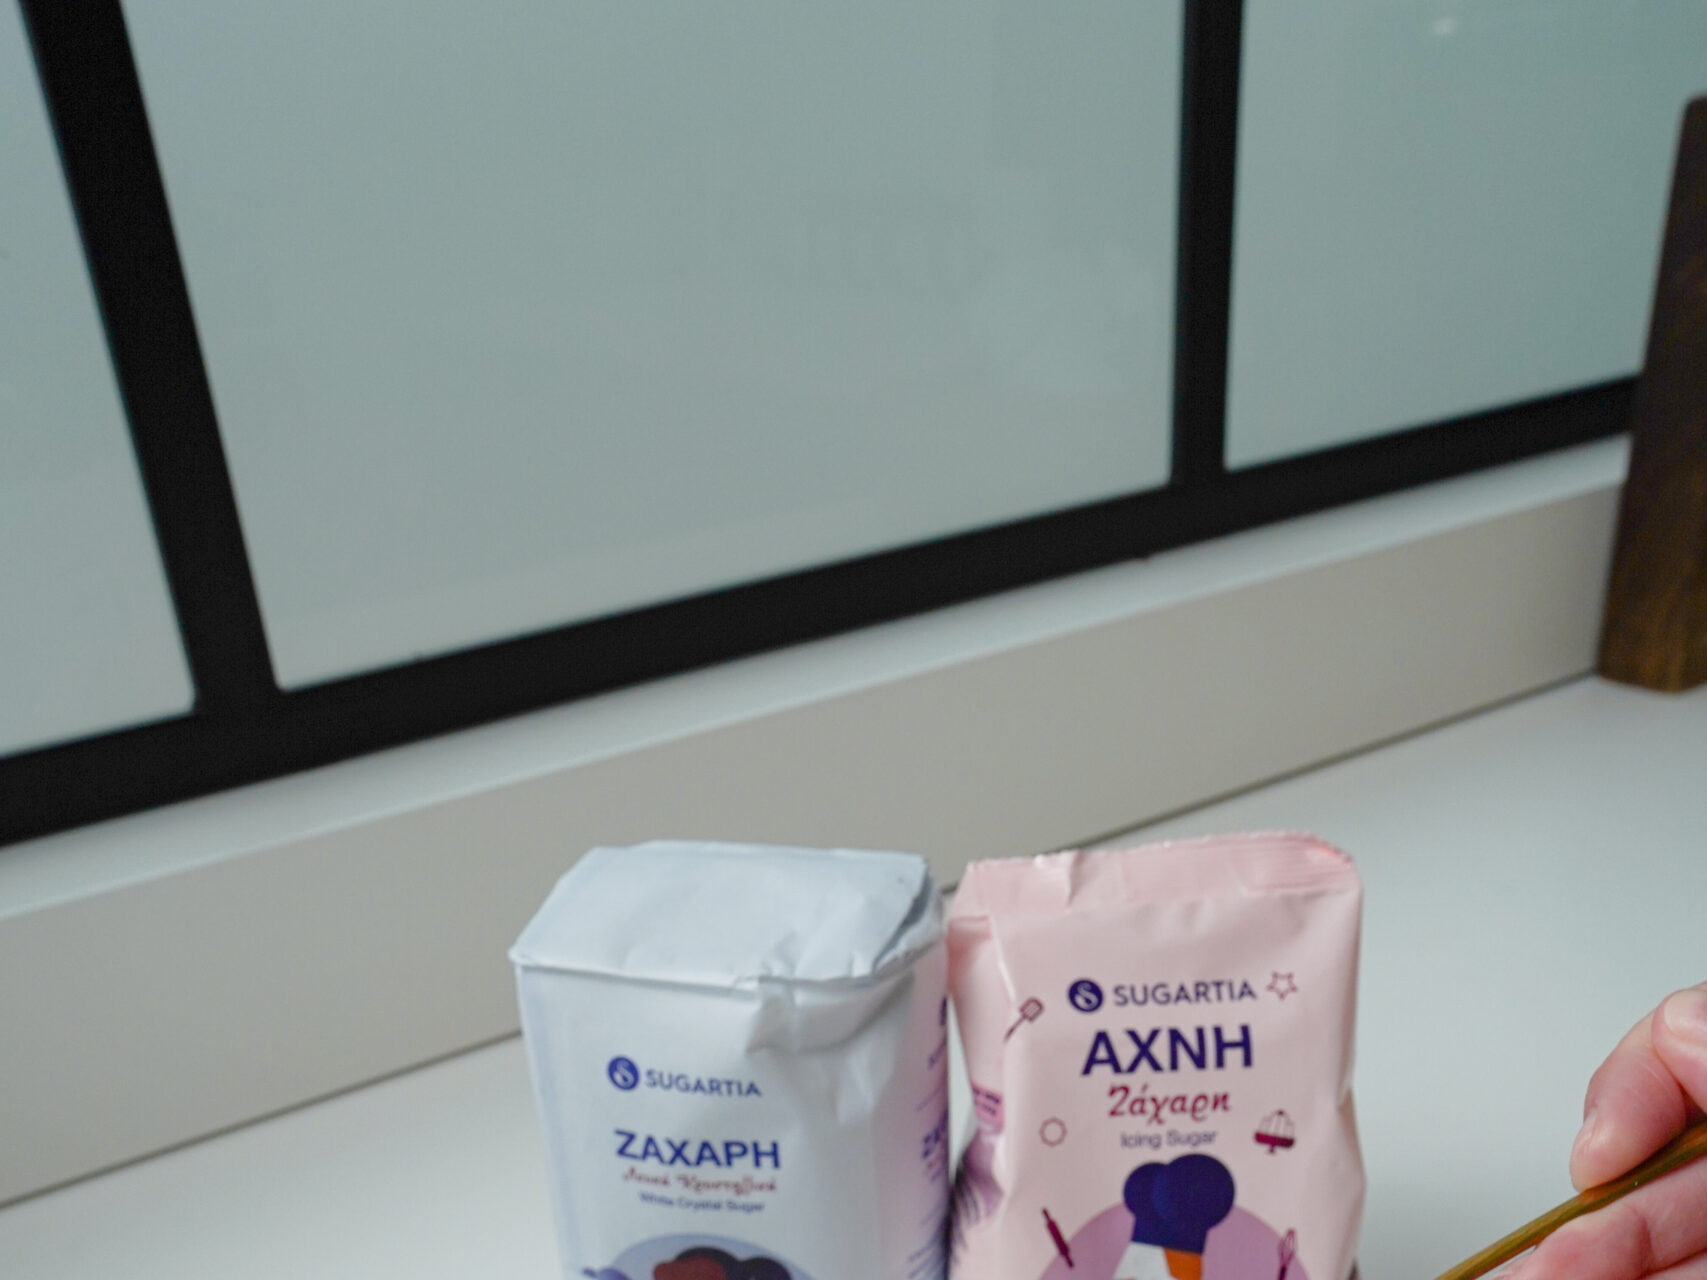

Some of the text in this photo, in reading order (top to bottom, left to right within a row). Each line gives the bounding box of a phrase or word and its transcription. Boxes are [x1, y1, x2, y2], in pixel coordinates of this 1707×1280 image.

[1113, 980, 1256, 1006] SUGARTIA
[1081, 1024, 1253, 1076] ΑΧΝΗ
[645, 1069, 762, 1097] SUGARTIA
[614, 1129, 780, 1169] ΖΑΧΑΡΗ
[1120, 1129, 1218, 1149] Icing Sugar
[677, 1197, 722, 1213] Crystal
[726, 1200, 765, 1213] Sugar
